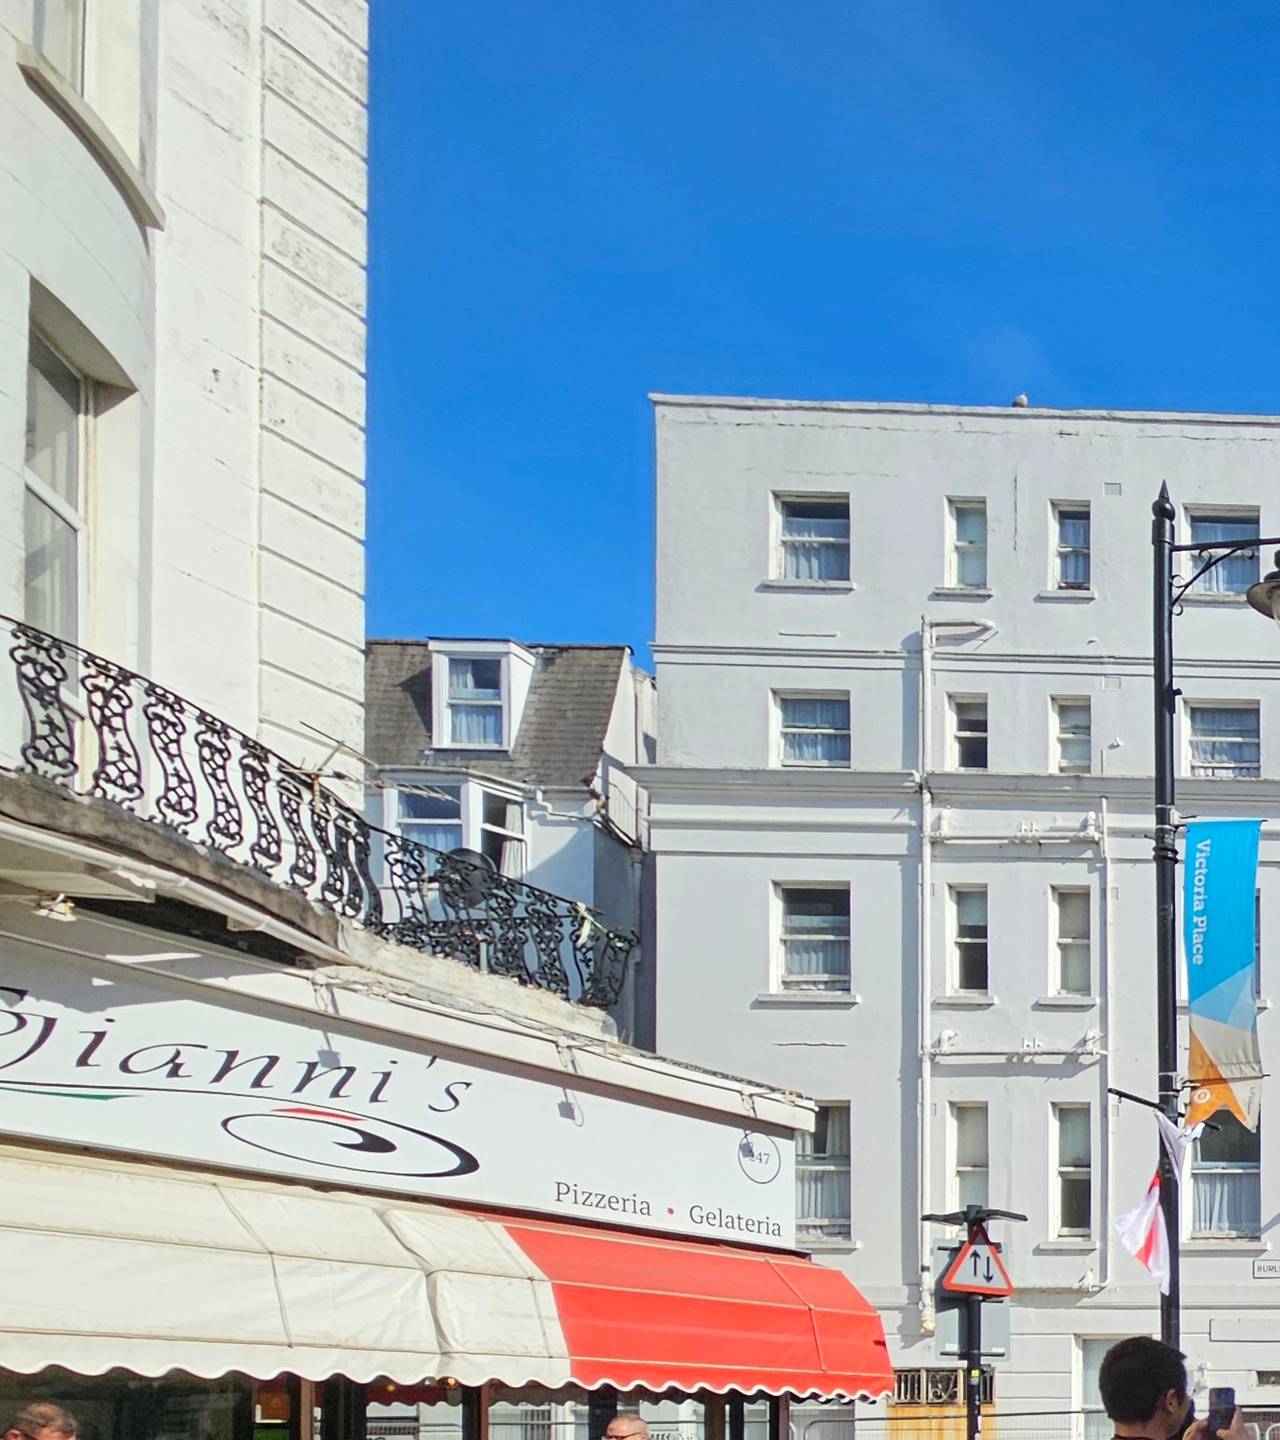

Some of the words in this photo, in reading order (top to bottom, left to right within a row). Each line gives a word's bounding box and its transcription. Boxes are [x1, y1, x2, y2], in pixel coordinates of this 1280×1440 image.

[1193, 839, 1212, 912] Victoria
[1192, 915, 1208, 965] Place
[554, 1181, 652, 1216] Pizzeria
[690, 1205, 782, 1237] Gelateria
